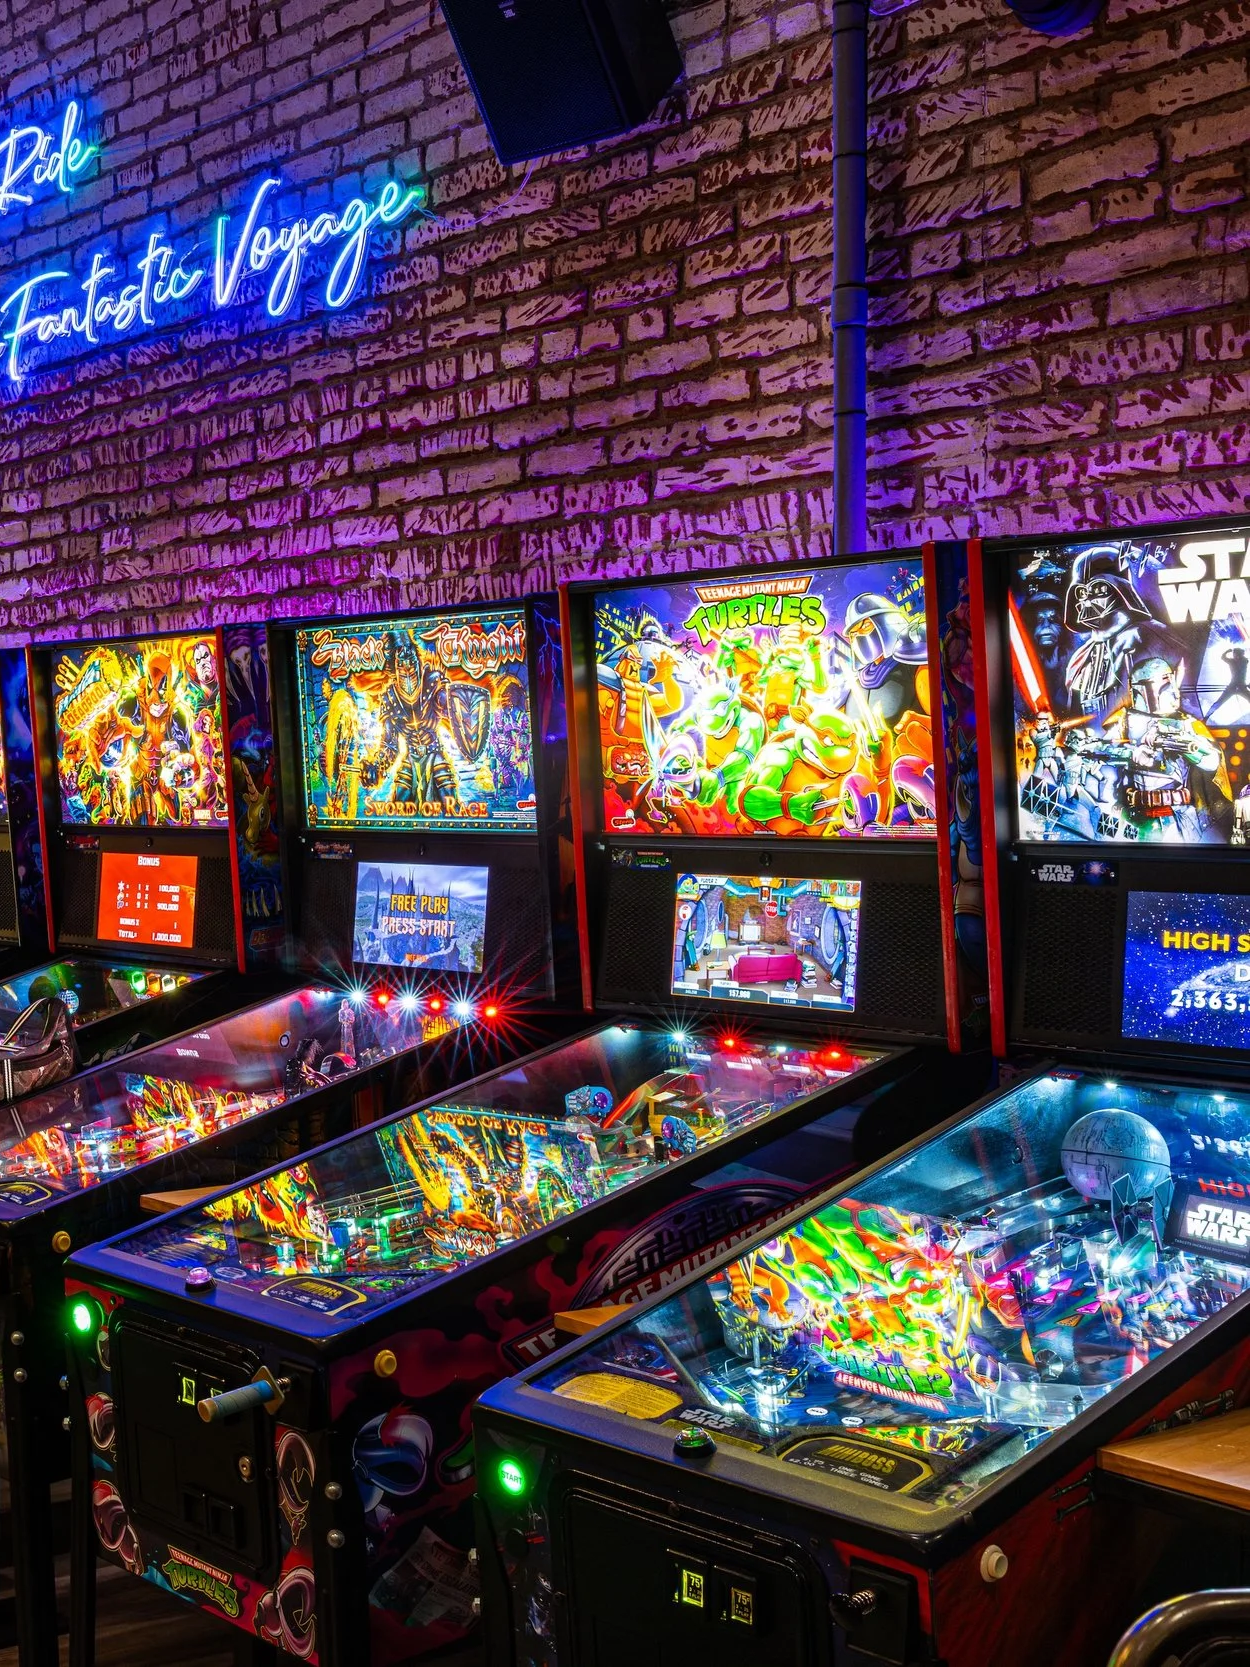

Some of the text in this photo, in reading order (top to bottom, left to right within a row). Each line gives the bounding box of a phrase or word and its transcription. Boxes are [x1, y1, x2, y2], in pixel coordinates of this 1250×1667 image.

[0, 234, 204, 381] Fantastic
[214, 179, 425, 316] Voyage
[699, 579, 807, 600] TEENAGE MUTANT NINJA
[684, 593, 827, 647] TURTLES
[311, 622, 527, 684] Black Knight
[67, 682, 110, 725] DEADPOOL
[363, 796, 417, 818] SWORD
[420, 800, 442, 816] OF
[444, 796, 488, 818] RAGE
[1038, 863, 1075, 874] STAR
[1038, 872, 1075, 882] WARS
[390, 893, 449, 915] FREE PLAY
[380, 915, 456, 938] PRESS START
[1163, 930, 1230, 952] HIGH
[1187, 1203, 1250, 1231] STAR
[1186, 1217, 1250, 1247] WARS
[679, 1410, 733, 1430] WARS
[686, 1408, 737, 1426] STAR
[817, 1444, 897, 1474] MINIBOSS
[501, 1470, 523, 1485] START
[829, 1467, 857, 1479] THREE
[860, 1476, 890, 1490] GAMES
[859, 1471, 884, 1482] GAME
[163, 1559, 238, 1617] TURTLES
